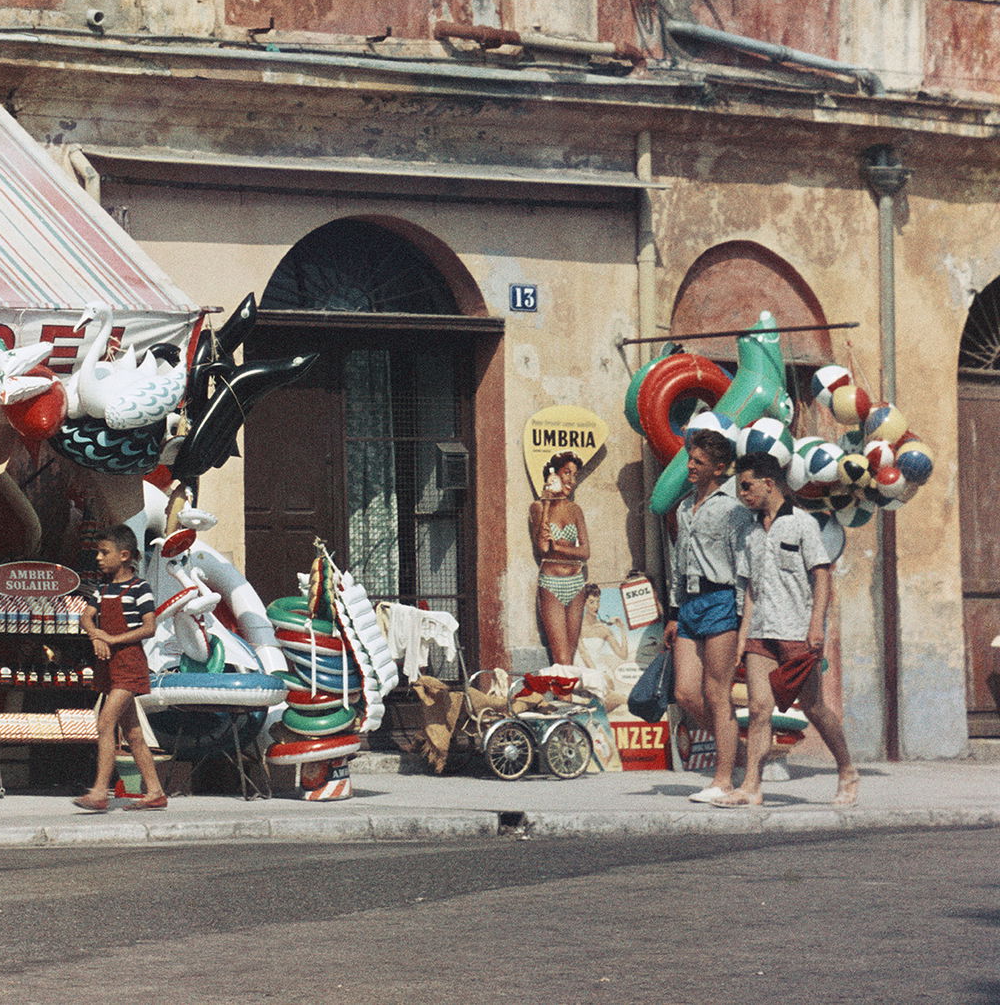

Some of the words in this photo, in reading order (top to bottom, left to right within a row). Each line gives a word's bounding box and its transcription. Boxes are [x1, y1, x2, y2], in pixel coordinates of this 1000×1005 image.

[515, 288, 535, 308] 13
[532, 429, 596, 448] UMBRIA
[8, 570, 55, 581] AMBRE
[5, 580, 60, 592] SOLAIRE
[625, 587, 651, 600] SKOL
